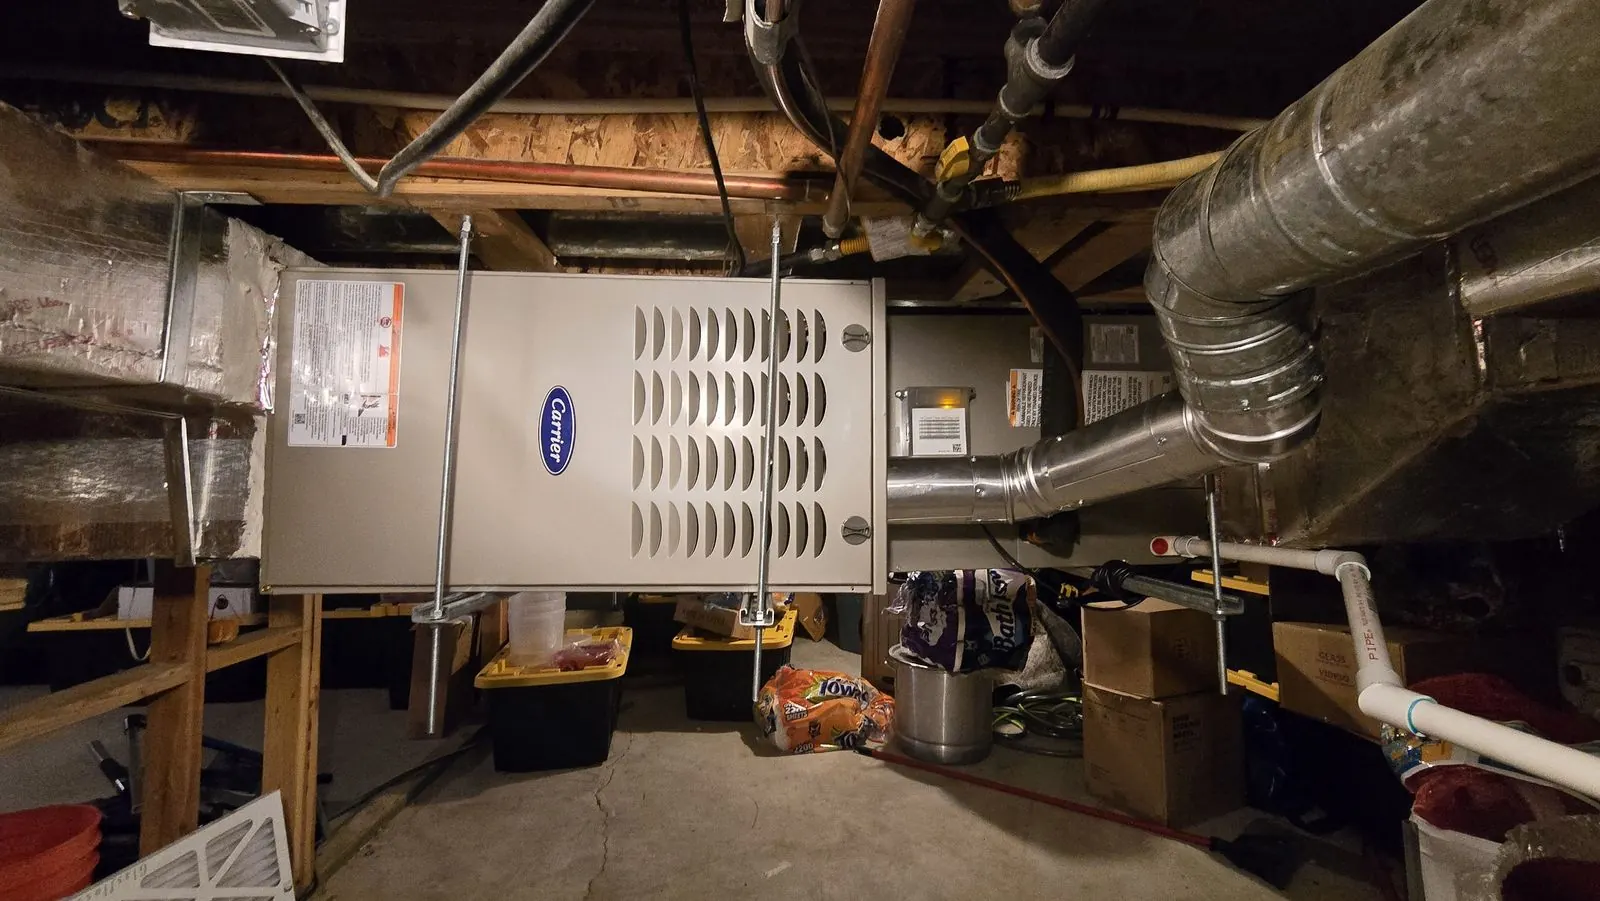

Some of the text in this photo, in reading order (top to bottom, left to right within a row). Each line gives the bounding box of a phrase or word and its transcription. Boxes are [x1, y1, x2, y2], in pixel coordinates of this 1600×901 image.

[549, 397, 566, 463] Carrier
[989, 604, 1015, 652] Bath
[1364, 632, 1378, 661] PIPE
